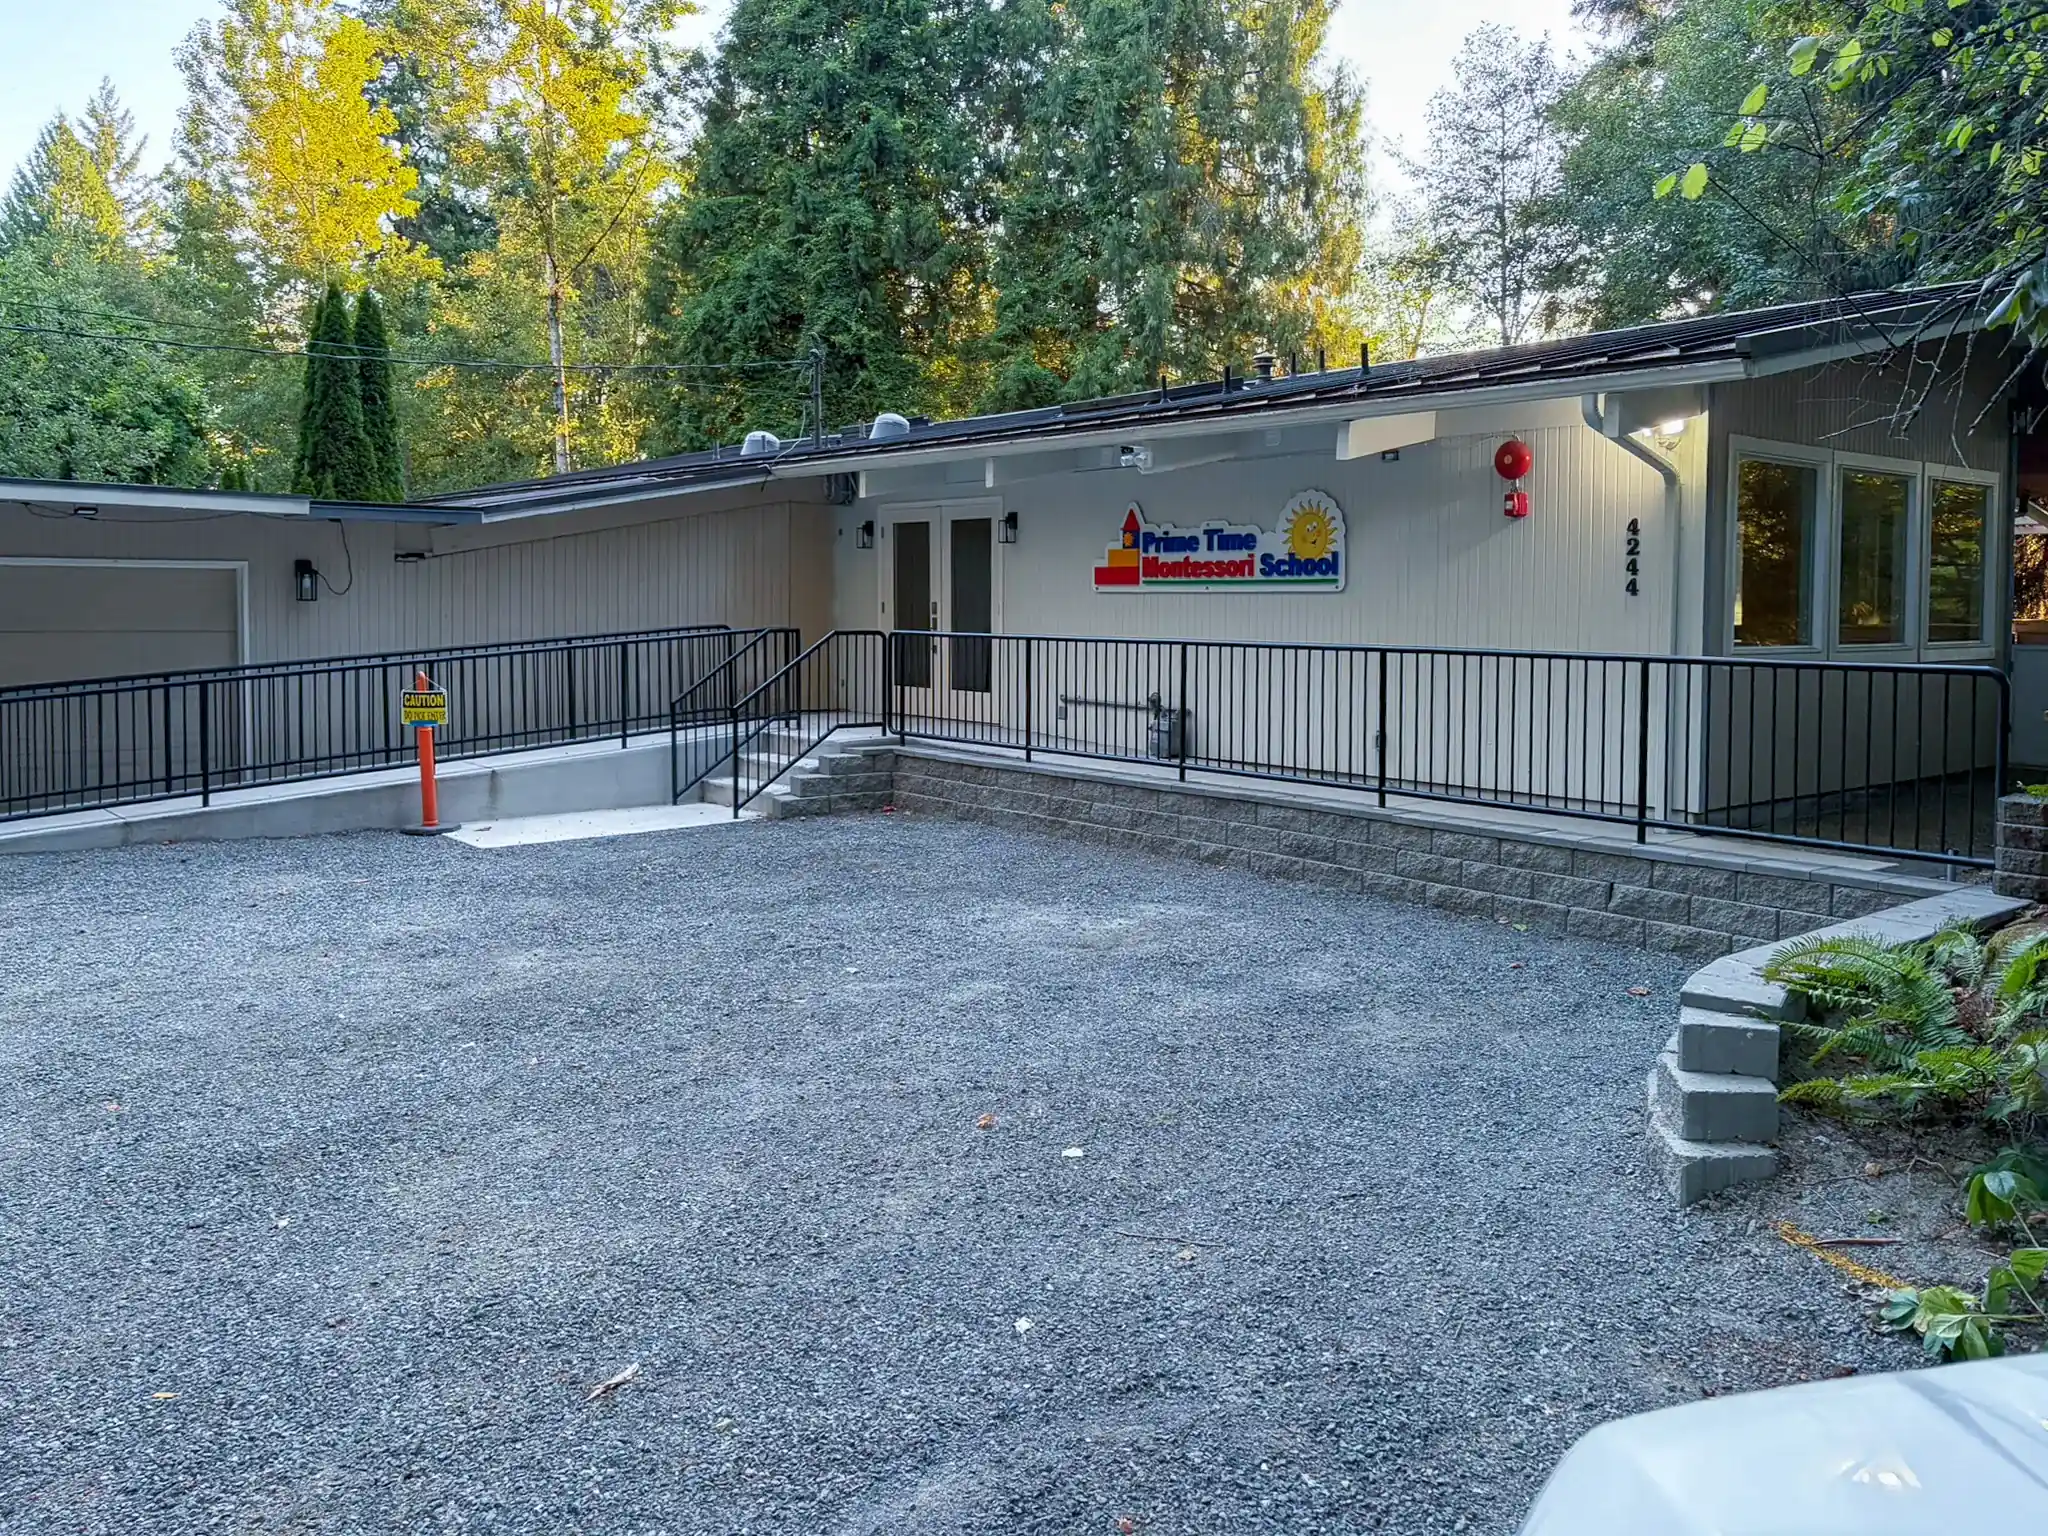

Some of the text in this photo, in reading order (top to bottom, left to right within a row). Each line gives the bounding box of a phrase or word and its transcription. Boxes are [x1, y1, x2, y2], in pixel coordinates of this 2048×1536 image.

[1142, 528, 1257, 554] Prime Time
[1142, 552, 1339, 579] Montessori School
[1625, 518, 1641, 596] 4244
[404, 694, 444, 706] CAUTION
